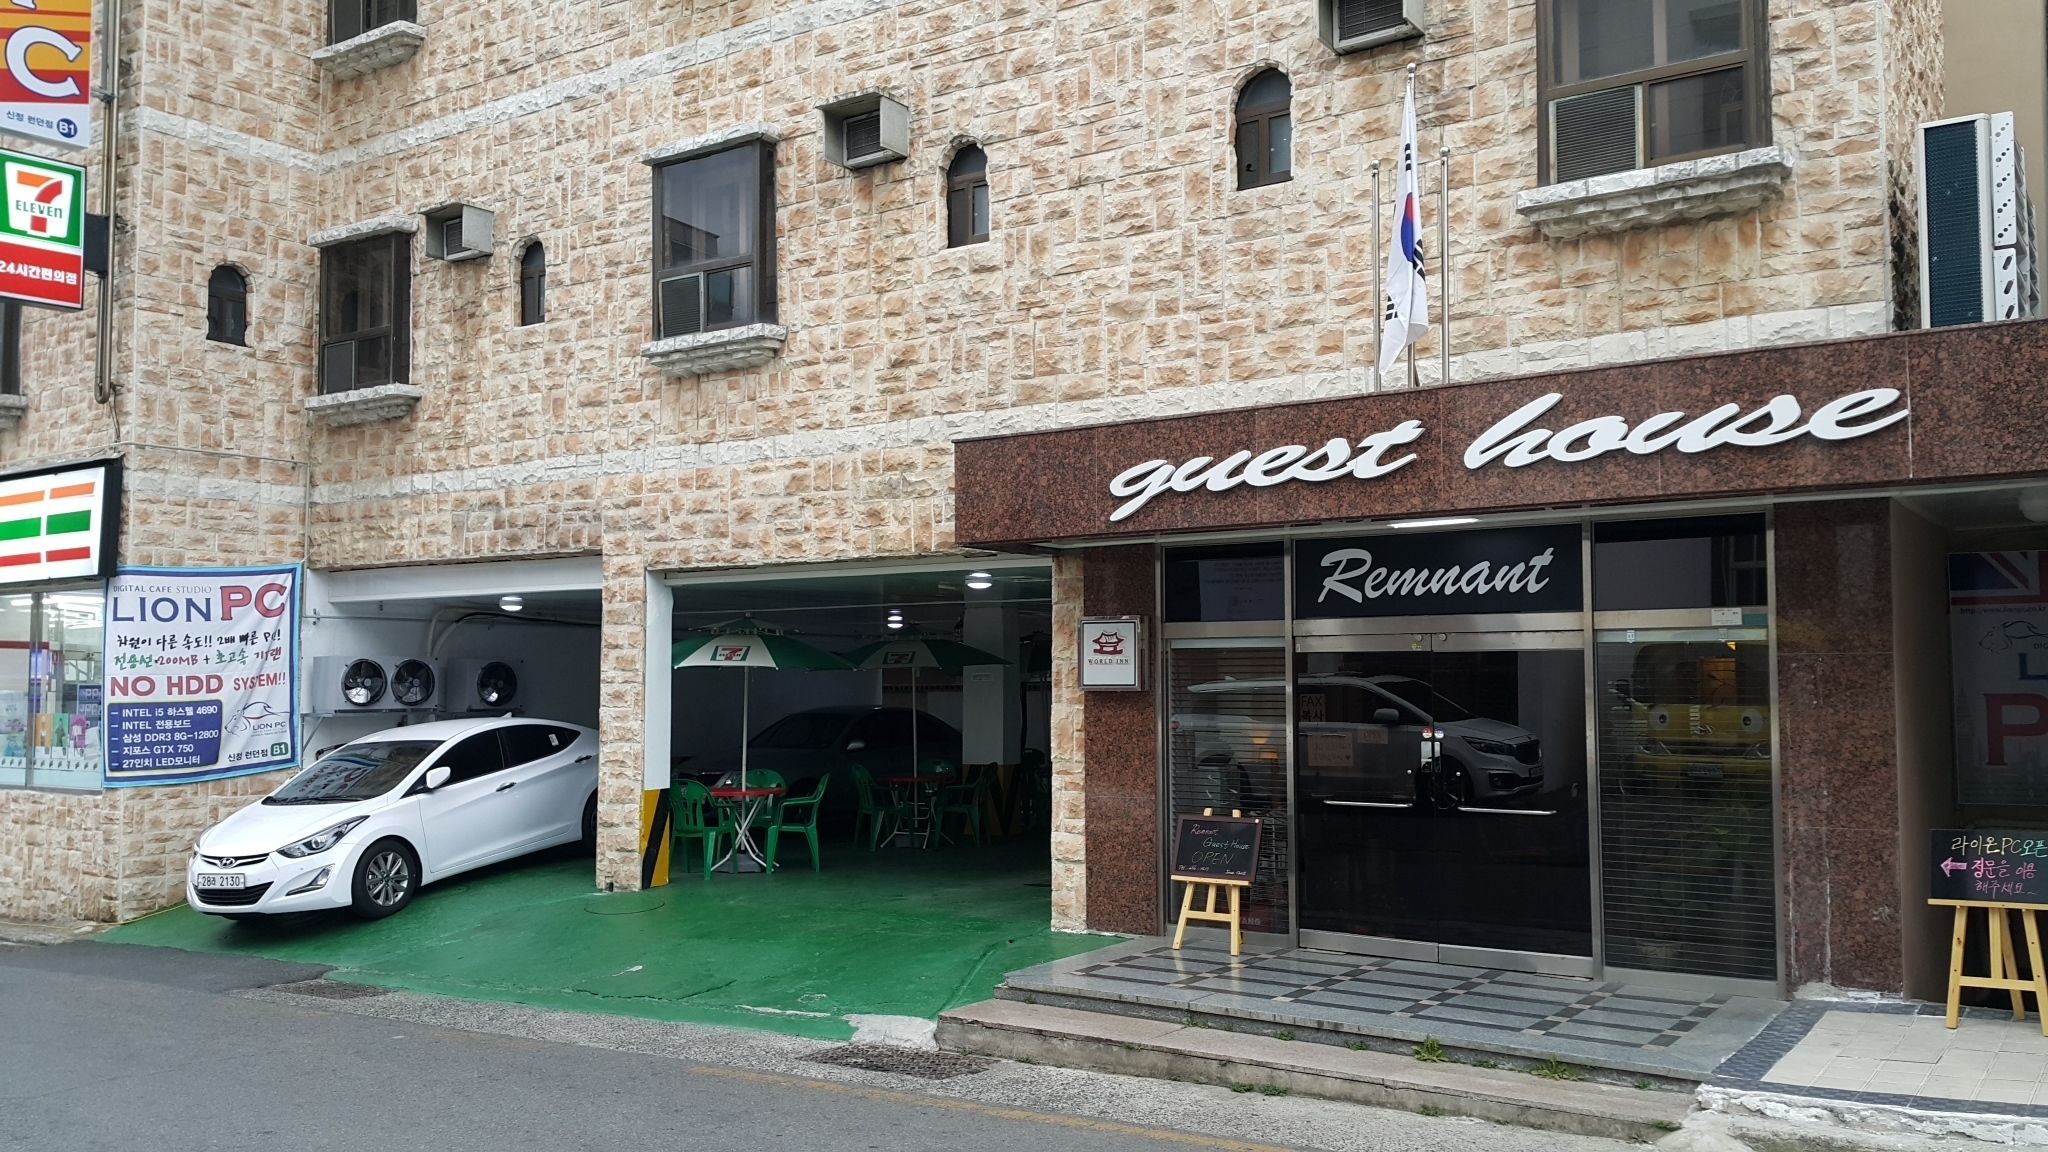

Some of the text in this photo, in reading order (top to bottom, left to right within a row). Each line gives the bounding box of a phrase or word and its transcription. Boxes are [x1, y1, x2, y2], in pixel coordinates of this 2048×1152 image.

[5, 26, 82, 98] C
[6, 109, 76, 136] 신정 런던점 B1
[17, 170, 62, 232] 7
[0, 260, 77, 286] 24시간편의점
[1109, 387, 1911, 523] guest house
[1317, 546, 1556, 603] Remnant
[113, 584, 212, 594] DIGITAL CAFE STUDIO
[112, 583, 287, 622] LION PC
[117, 634, 152, 650] 차원이
[156, 633, 178, 652] 다른
[181, 634, 213, 651] 속도!!
[217, 635, 236, 647] 2배
[238, 631, 259, 647] 빠른
[213, 647, 250, 666] 초고속
[110, 676, 156, 697] NO
[166, 674, 224, 696] HDD
[1301, 696, 1323, 707] FAX
[122, 708, 152, 718] INTEL
[155, 707, 164, 717] i5
[196, 705, 218, 715] 4690
[122, 720, 192, 731] INTEL 전용보드
[253, 723, 273, 731] LION
[122, 730, 219, 743] 삼성 DDR3 8G-12800
[122, 744, 194, 756] 지포스 GTX 750
[228, 744, 286, 762] 신정 런던점 B1
[122, 755, 200, 768] 27인치 LED모니터
[1191, 850, 1234, 865] OPEN
[1971, 857, 2038, 880] 정문을 이용
[220, 876, 241, 887] 2130
